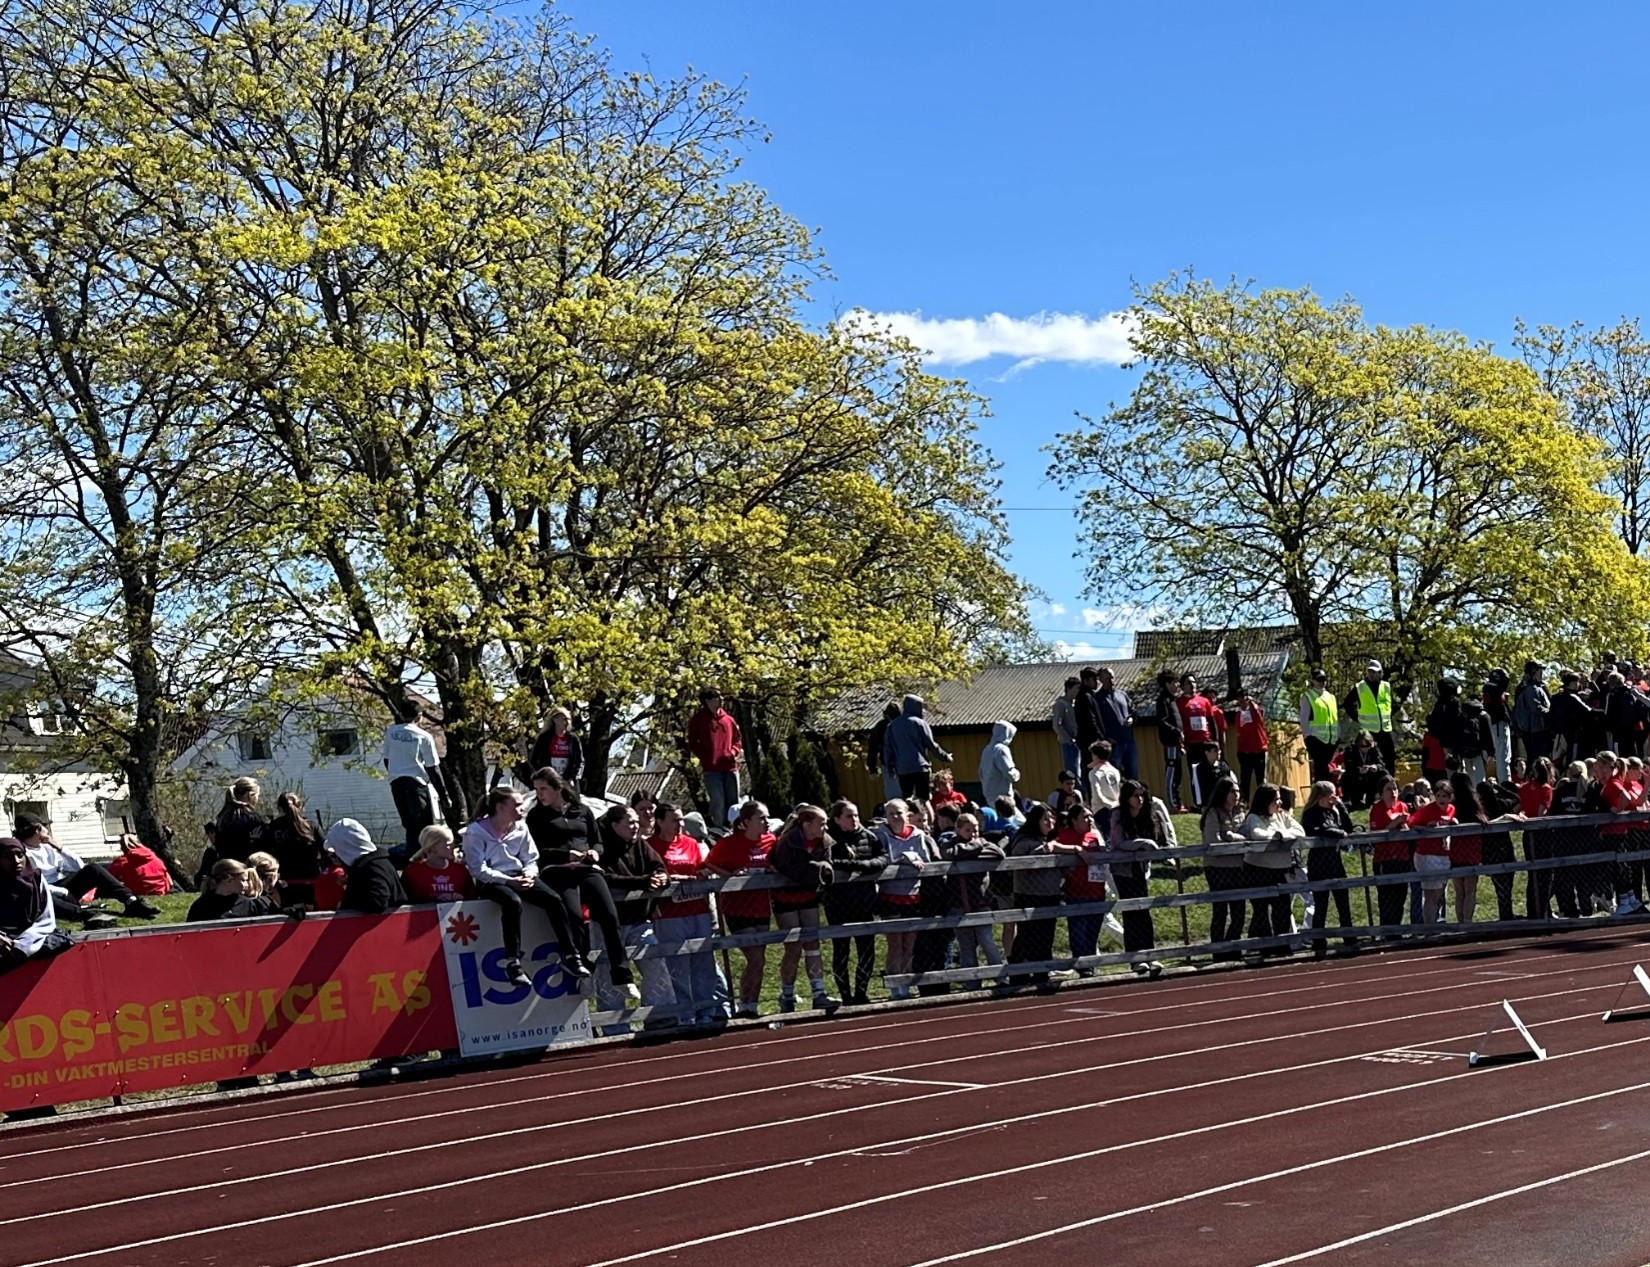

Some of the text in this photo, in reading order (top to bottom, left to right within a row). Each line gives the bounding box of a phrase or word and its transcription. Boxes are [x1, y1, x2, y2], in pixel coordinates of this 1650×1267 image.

[431, 883, 455, 892] TINE
[367, 969, 432, 1017] AS
[459, 942, 581, 1009] isa
[471, 1021, 588, 1045] www.isanorge.no
[55, 1040, 273, 1083] VAKTMESTERSENTRAL
